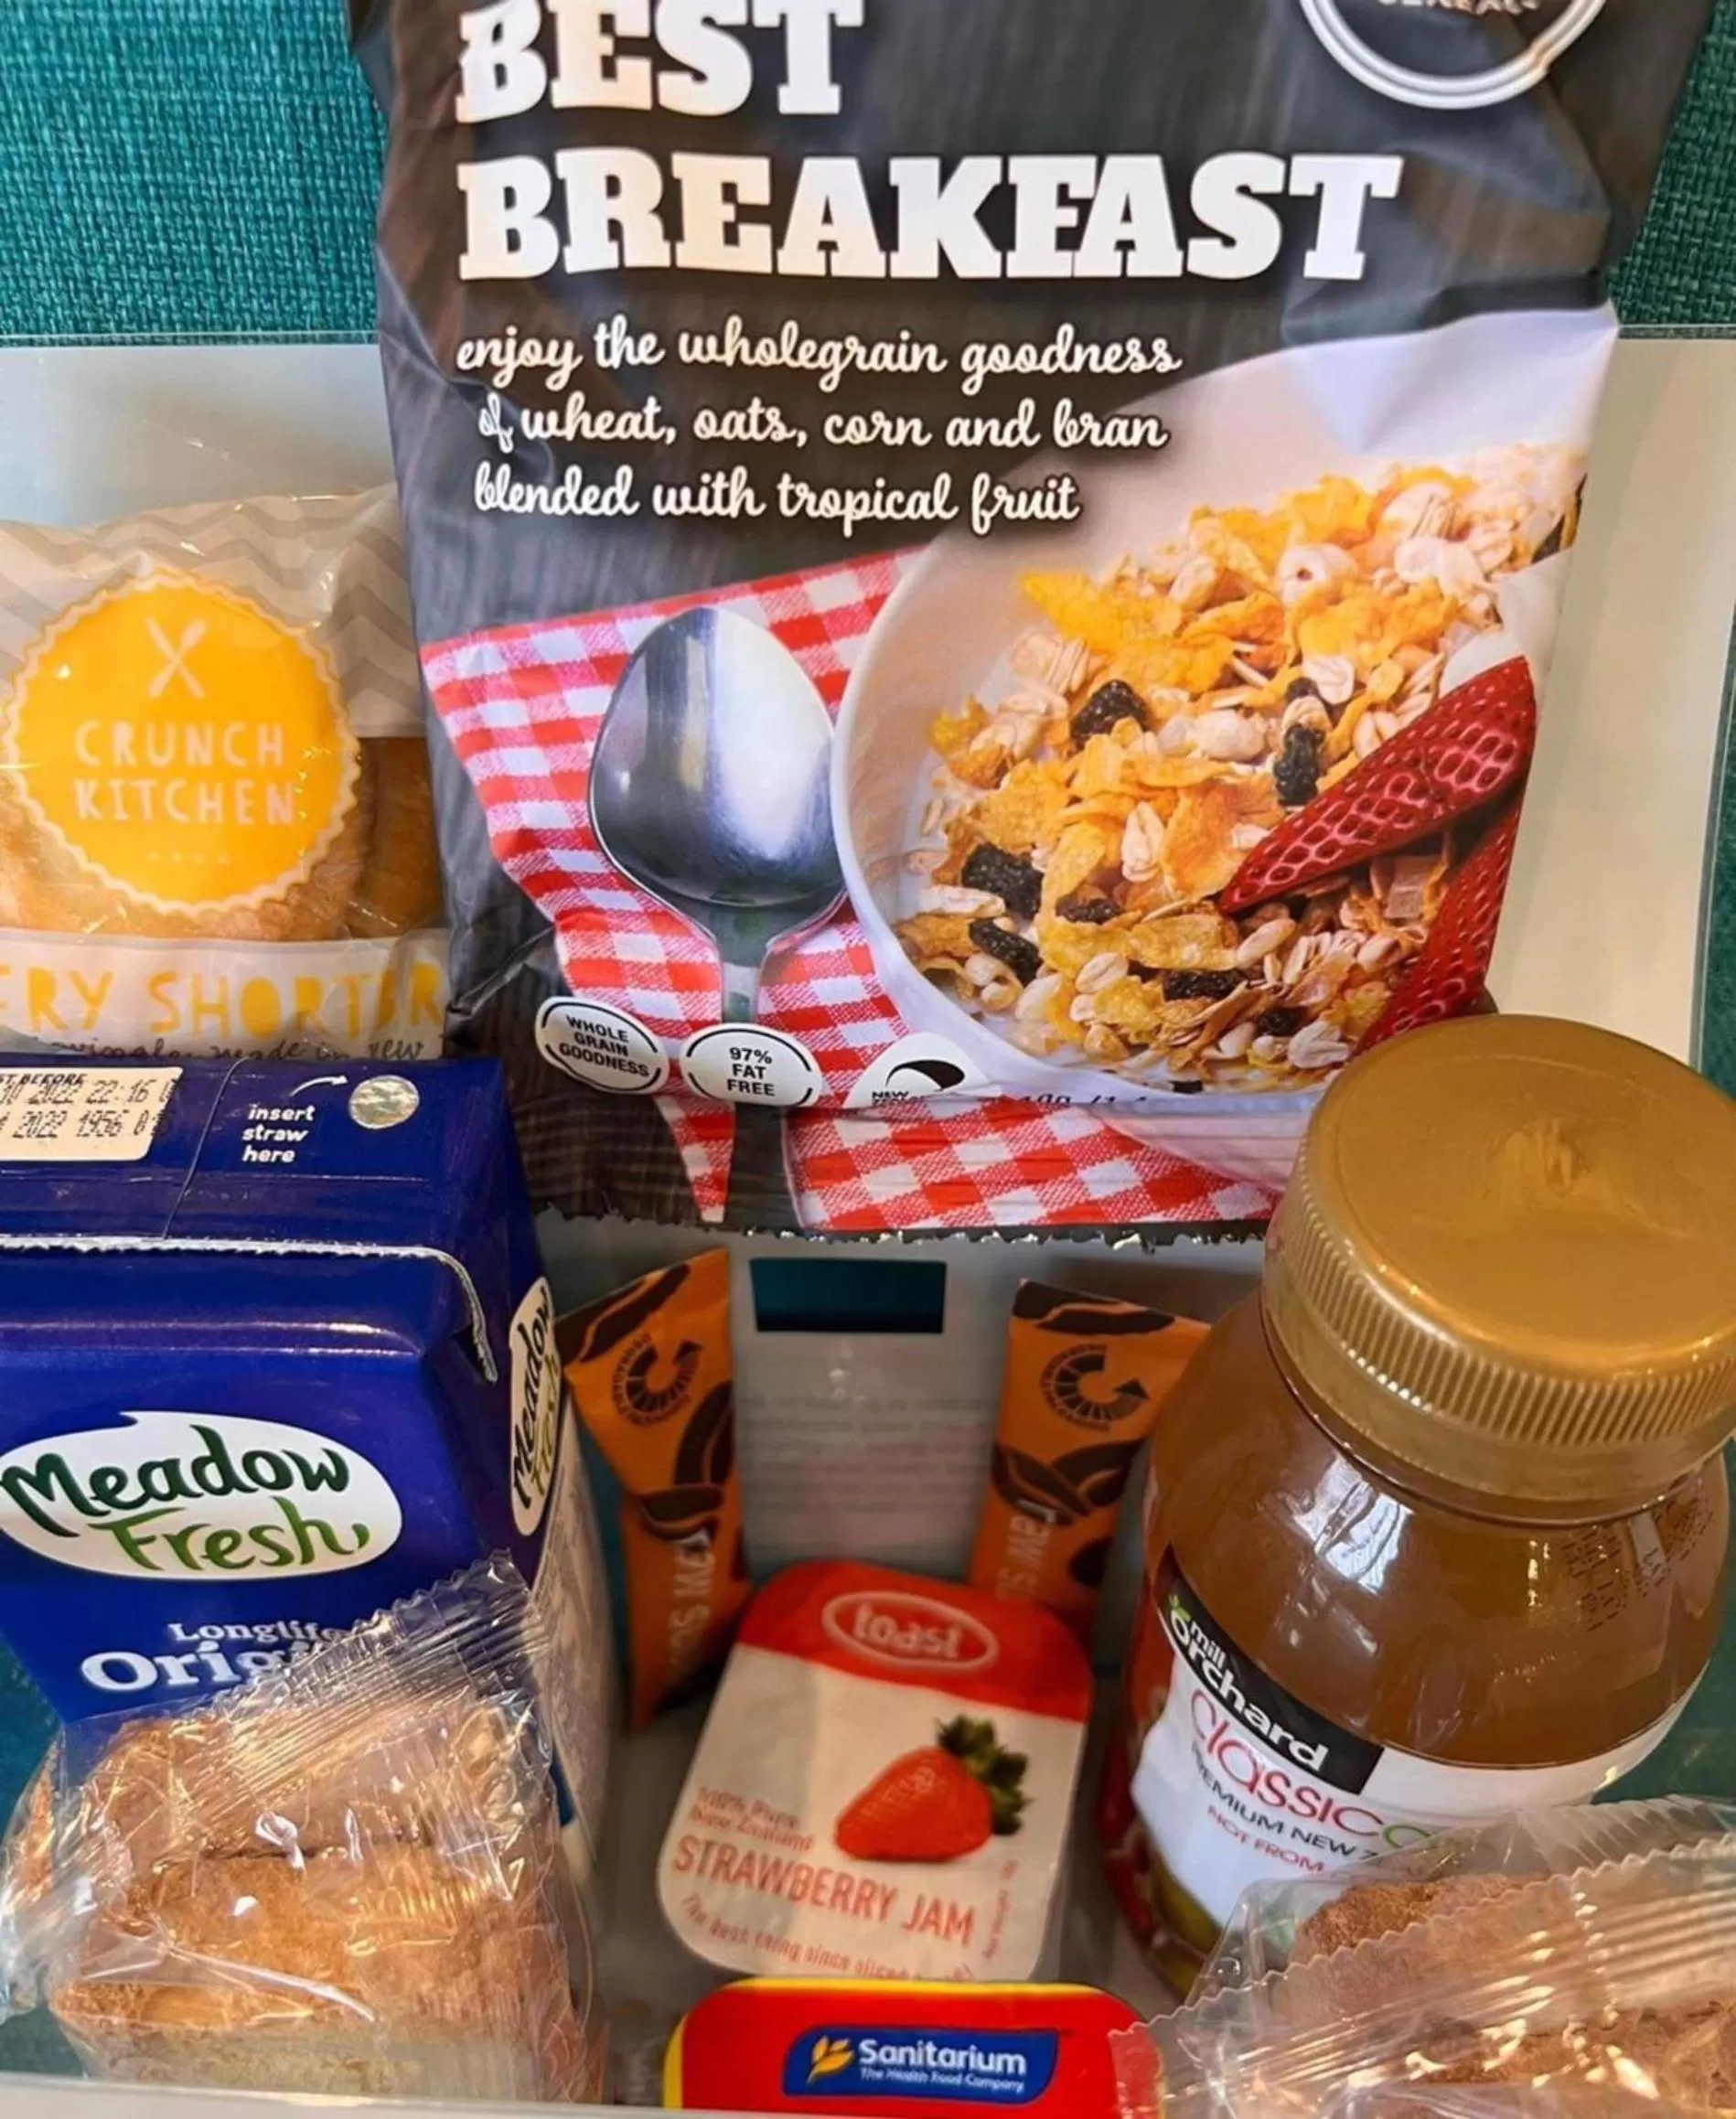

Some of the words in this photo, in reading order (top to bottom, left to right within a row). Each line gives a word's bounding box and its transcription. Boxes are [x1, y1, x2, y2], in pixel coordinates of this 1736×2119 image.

[457, 0, 866, 123] BEST
[457, 147, 1404, 281] BREAKFAST
[456, 325, 584, 391] enjoy
[593, 314, 666, 369] the
[679, 315, 948, 393] wholegrain
[960, 323, 1184, 396] goodness
[478, 391, 515, 454] of
[520, 391, 677, 445] wheat,
[693, 396, 808, 448] oats,
[824, 411, 933, 446] corn
[946, 397, 1042, 447] and
[1053, 397, 1170, 447] bran
[474, 460, 641, 517] blended
[652, 465, 767, 519] with
[777, 472, 959, 539] tropical
[971, 472, 1080, 535] fruit
[74, 718, 285, 768] CRUNCH
[72, 777, 295, 826] KITCHEN
[565, 1014, 629, 1043] WHOLE
[573, 1032, 629, 1056] GRAIN
[558, 1042, 650, 1076] GOODNESS
[729, 1047, 773, 1065] 97%
[732, 1064, 767, 1081] FAT
[19, 1073, 88, 1086] BEFORE
[86, 1079, 156, 1103] 22:16
[726, 1079, 776, 1097] FREE
[12, 1109, 69, 1138] 2022
[241, 1123, 309, 1141] straw
[247, 1102, 316, 1121] insert
[241, 1144, 295, 1163] here
[0, 1423, 350, 1537] Meadow
[86, 1494, 371, 1571] Fresh
[852, 1600, 961, 1659] toast
[1190, 1621, 1227, 1670] mill
[80, 1641, 311, 1692] Orig
[1170, 1609, 1330, 1771] orchard
[1206, 1804, 1251, 1845] NOT
[1253, 1837, 1325, 1873] FROM
[1290, 1826, 1356, 1857] NEW
[670, 1833, 900, 1922] STRAWBERRY
[901, 1891, 977, 1948] JAM
[859, 2038, 1027, 2076] Sanitarium
[963, 2072, 1025, 2095] Company
